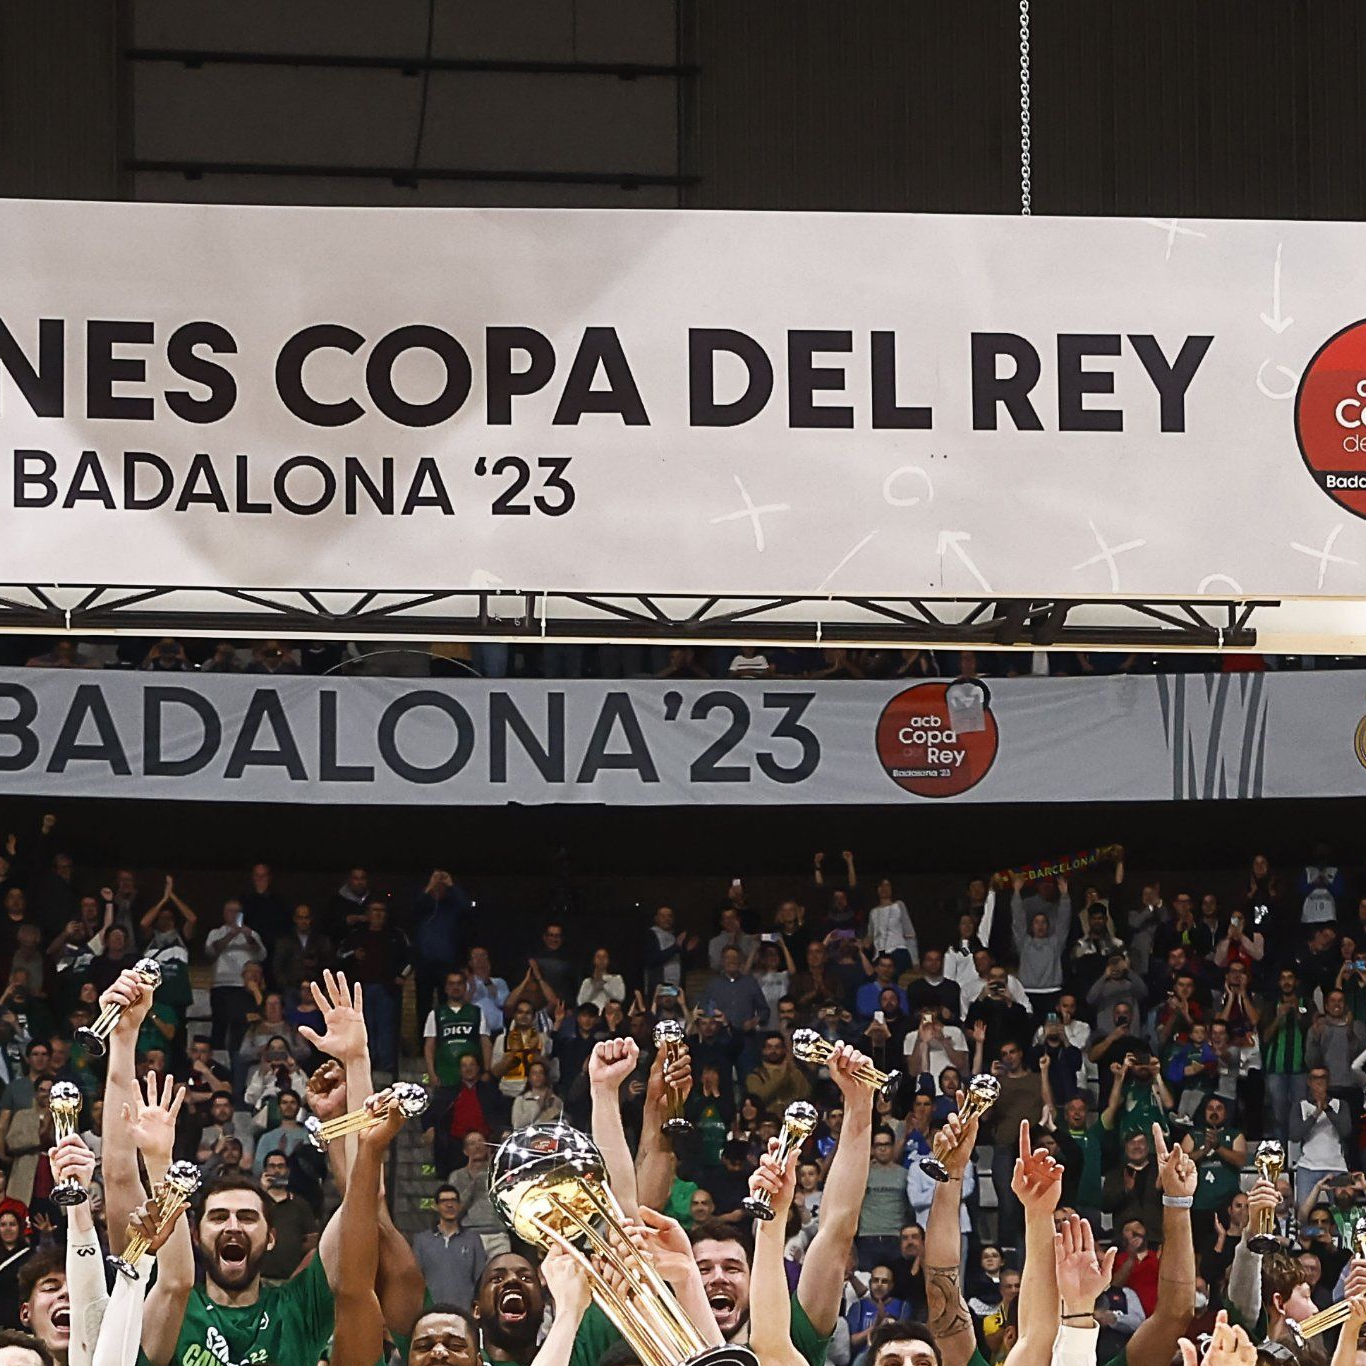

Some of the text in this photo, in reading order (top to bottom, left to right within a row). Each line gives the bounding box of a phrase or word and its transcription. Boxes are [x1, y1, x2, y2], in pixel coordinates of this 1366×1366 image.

[275, 323, 650, 428] COPA
[690, 328, 933, 429] DEL
[971, 332, 1215, 433] REY
[13, 450, 575, 517] BADALONA '23
[911, 715, 942, 727] acb
[898, 728, 957, 747] Copa
[927, 747, 966, 767] Rey
